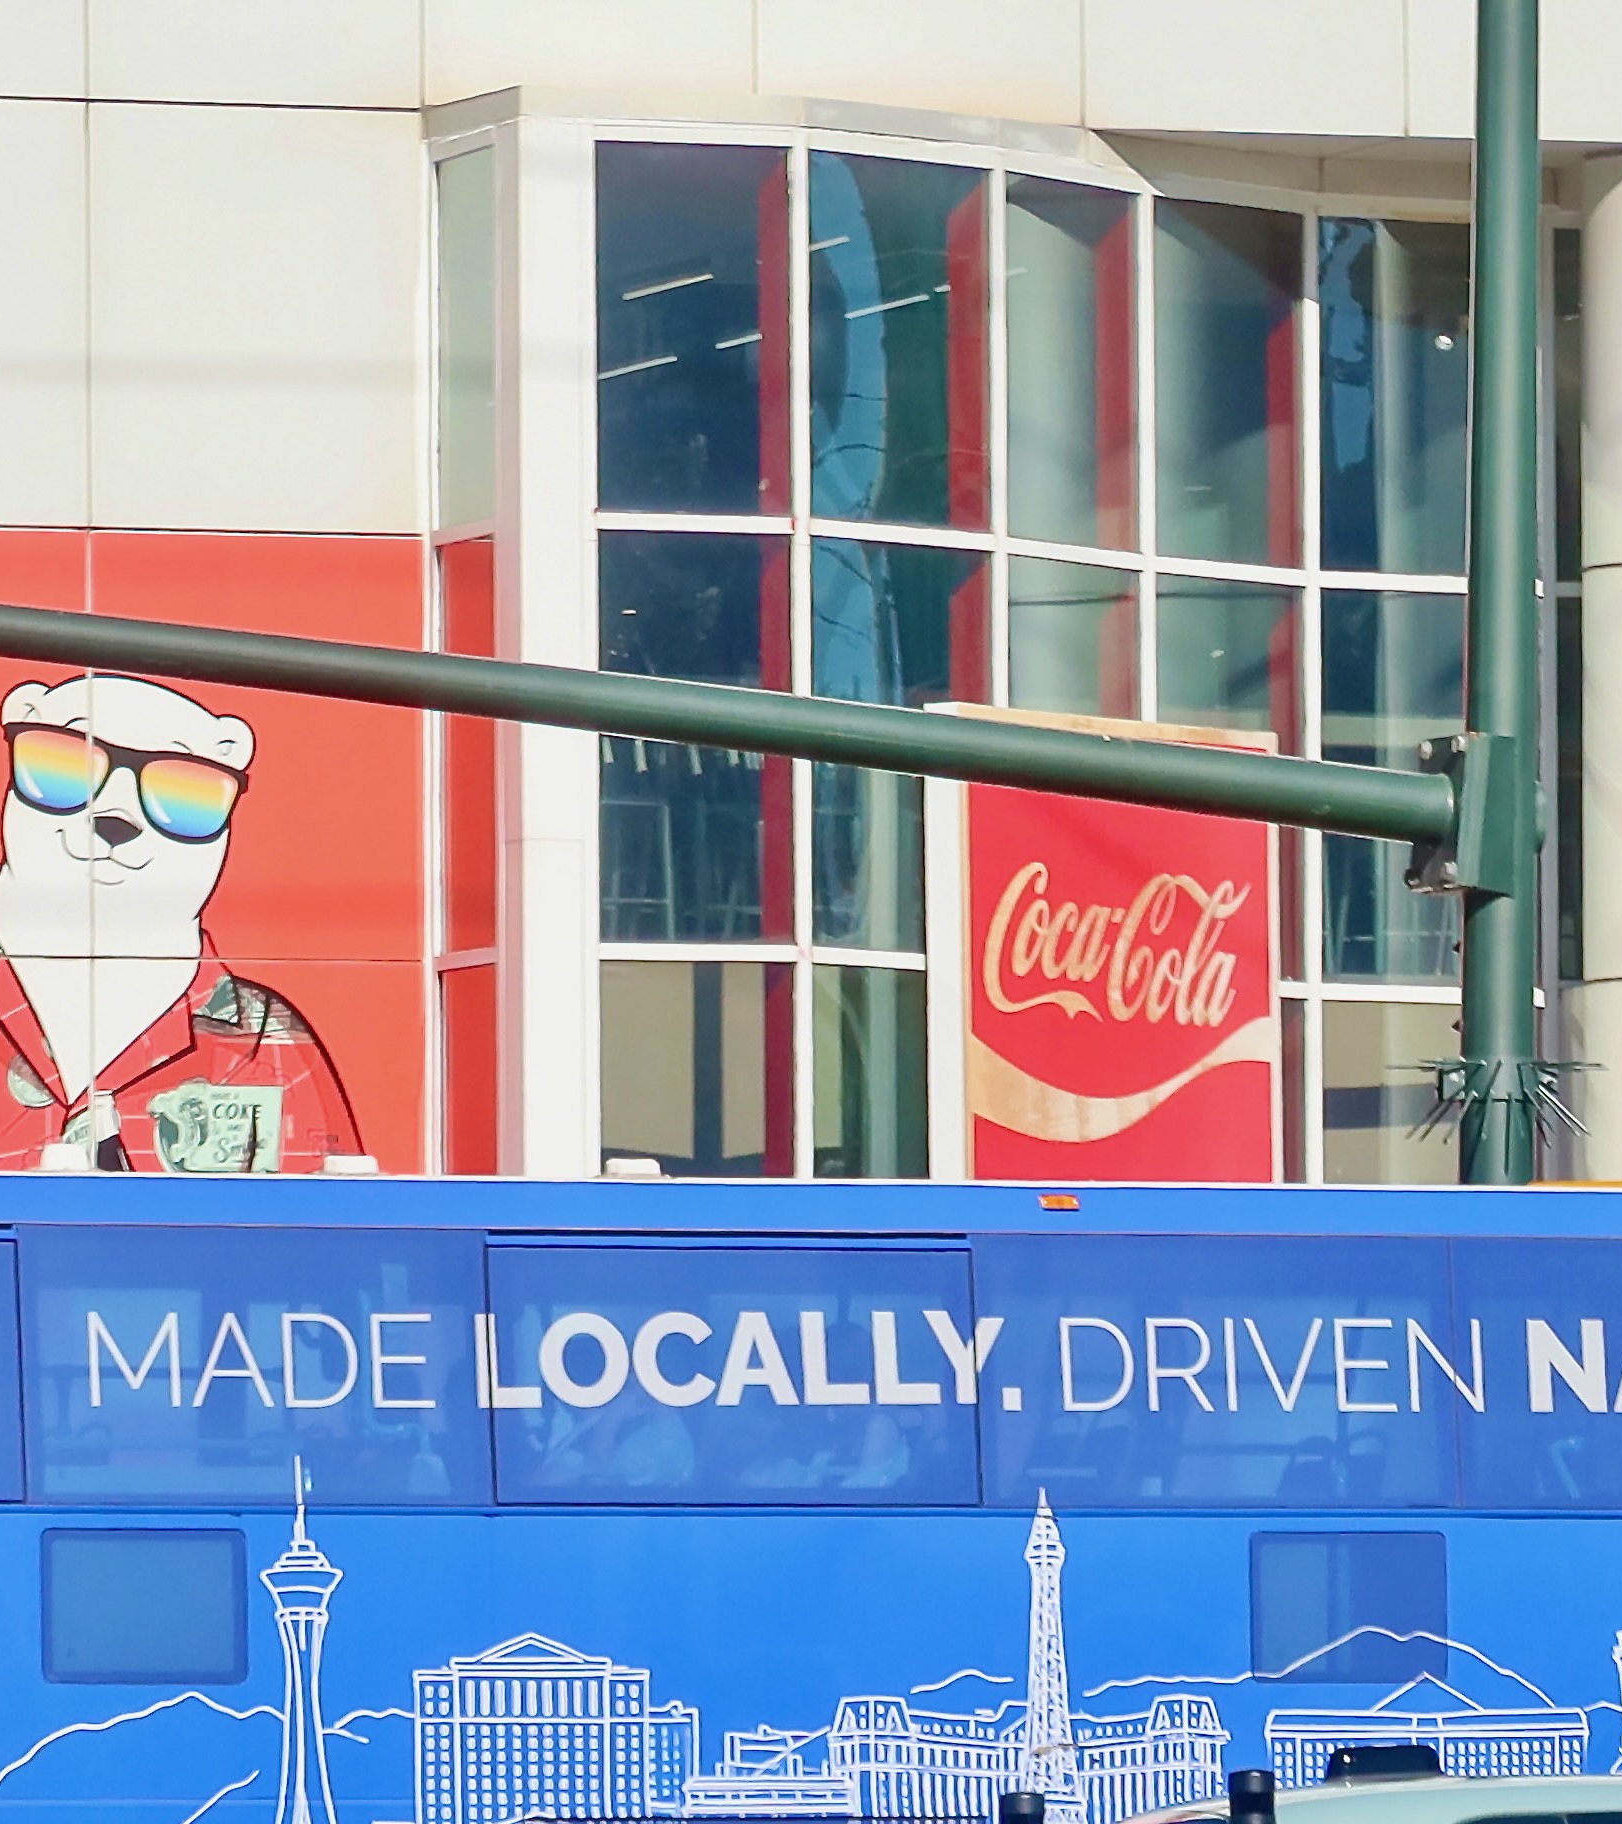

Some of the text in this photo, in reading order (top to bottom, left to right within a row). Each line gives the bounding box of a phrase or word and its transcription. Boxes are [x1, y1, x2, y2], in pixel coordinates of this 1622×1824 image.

[984, 862, 1251, 1028] Coca-Cola
[86, 1311, 436, 1410] MADE
[475, 1309, 1022, 1412] LOCALLY.
[1059, 1316, 1485, 1413] DRIVEN
